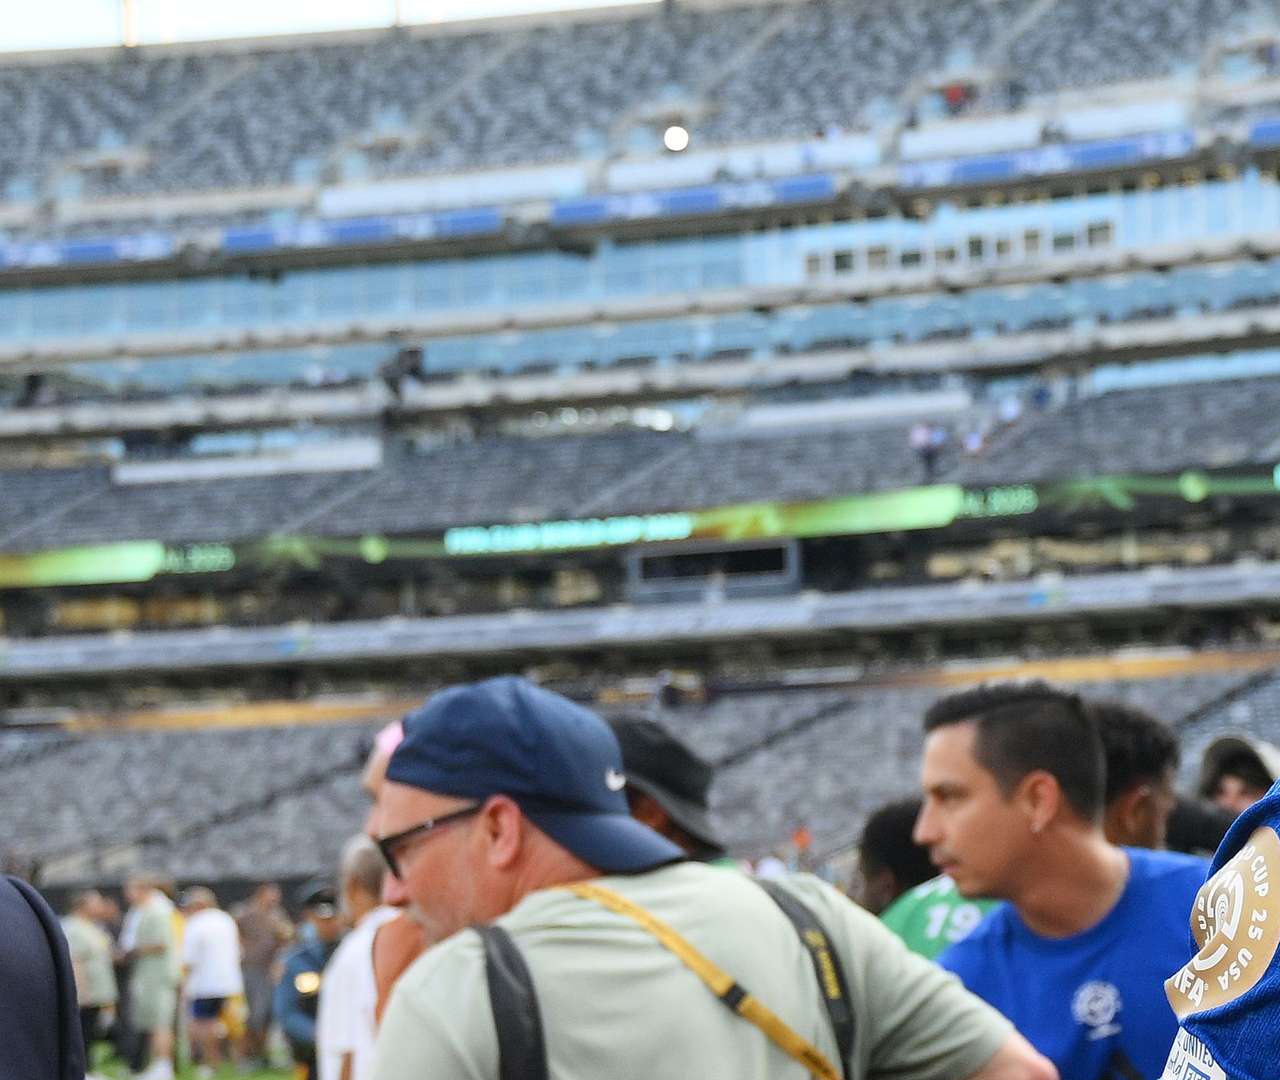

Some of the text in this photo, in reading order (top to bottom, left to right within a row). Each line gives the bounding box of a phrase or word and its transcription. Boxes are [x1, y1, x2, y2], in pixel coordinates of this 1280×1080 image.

[1250, 855, 1270, 897] CUP
[1247, 909, 1268, 941] 25
[1174, 968, 1206, 1007] IFA
[1217, 947, 1253, 991] USA
